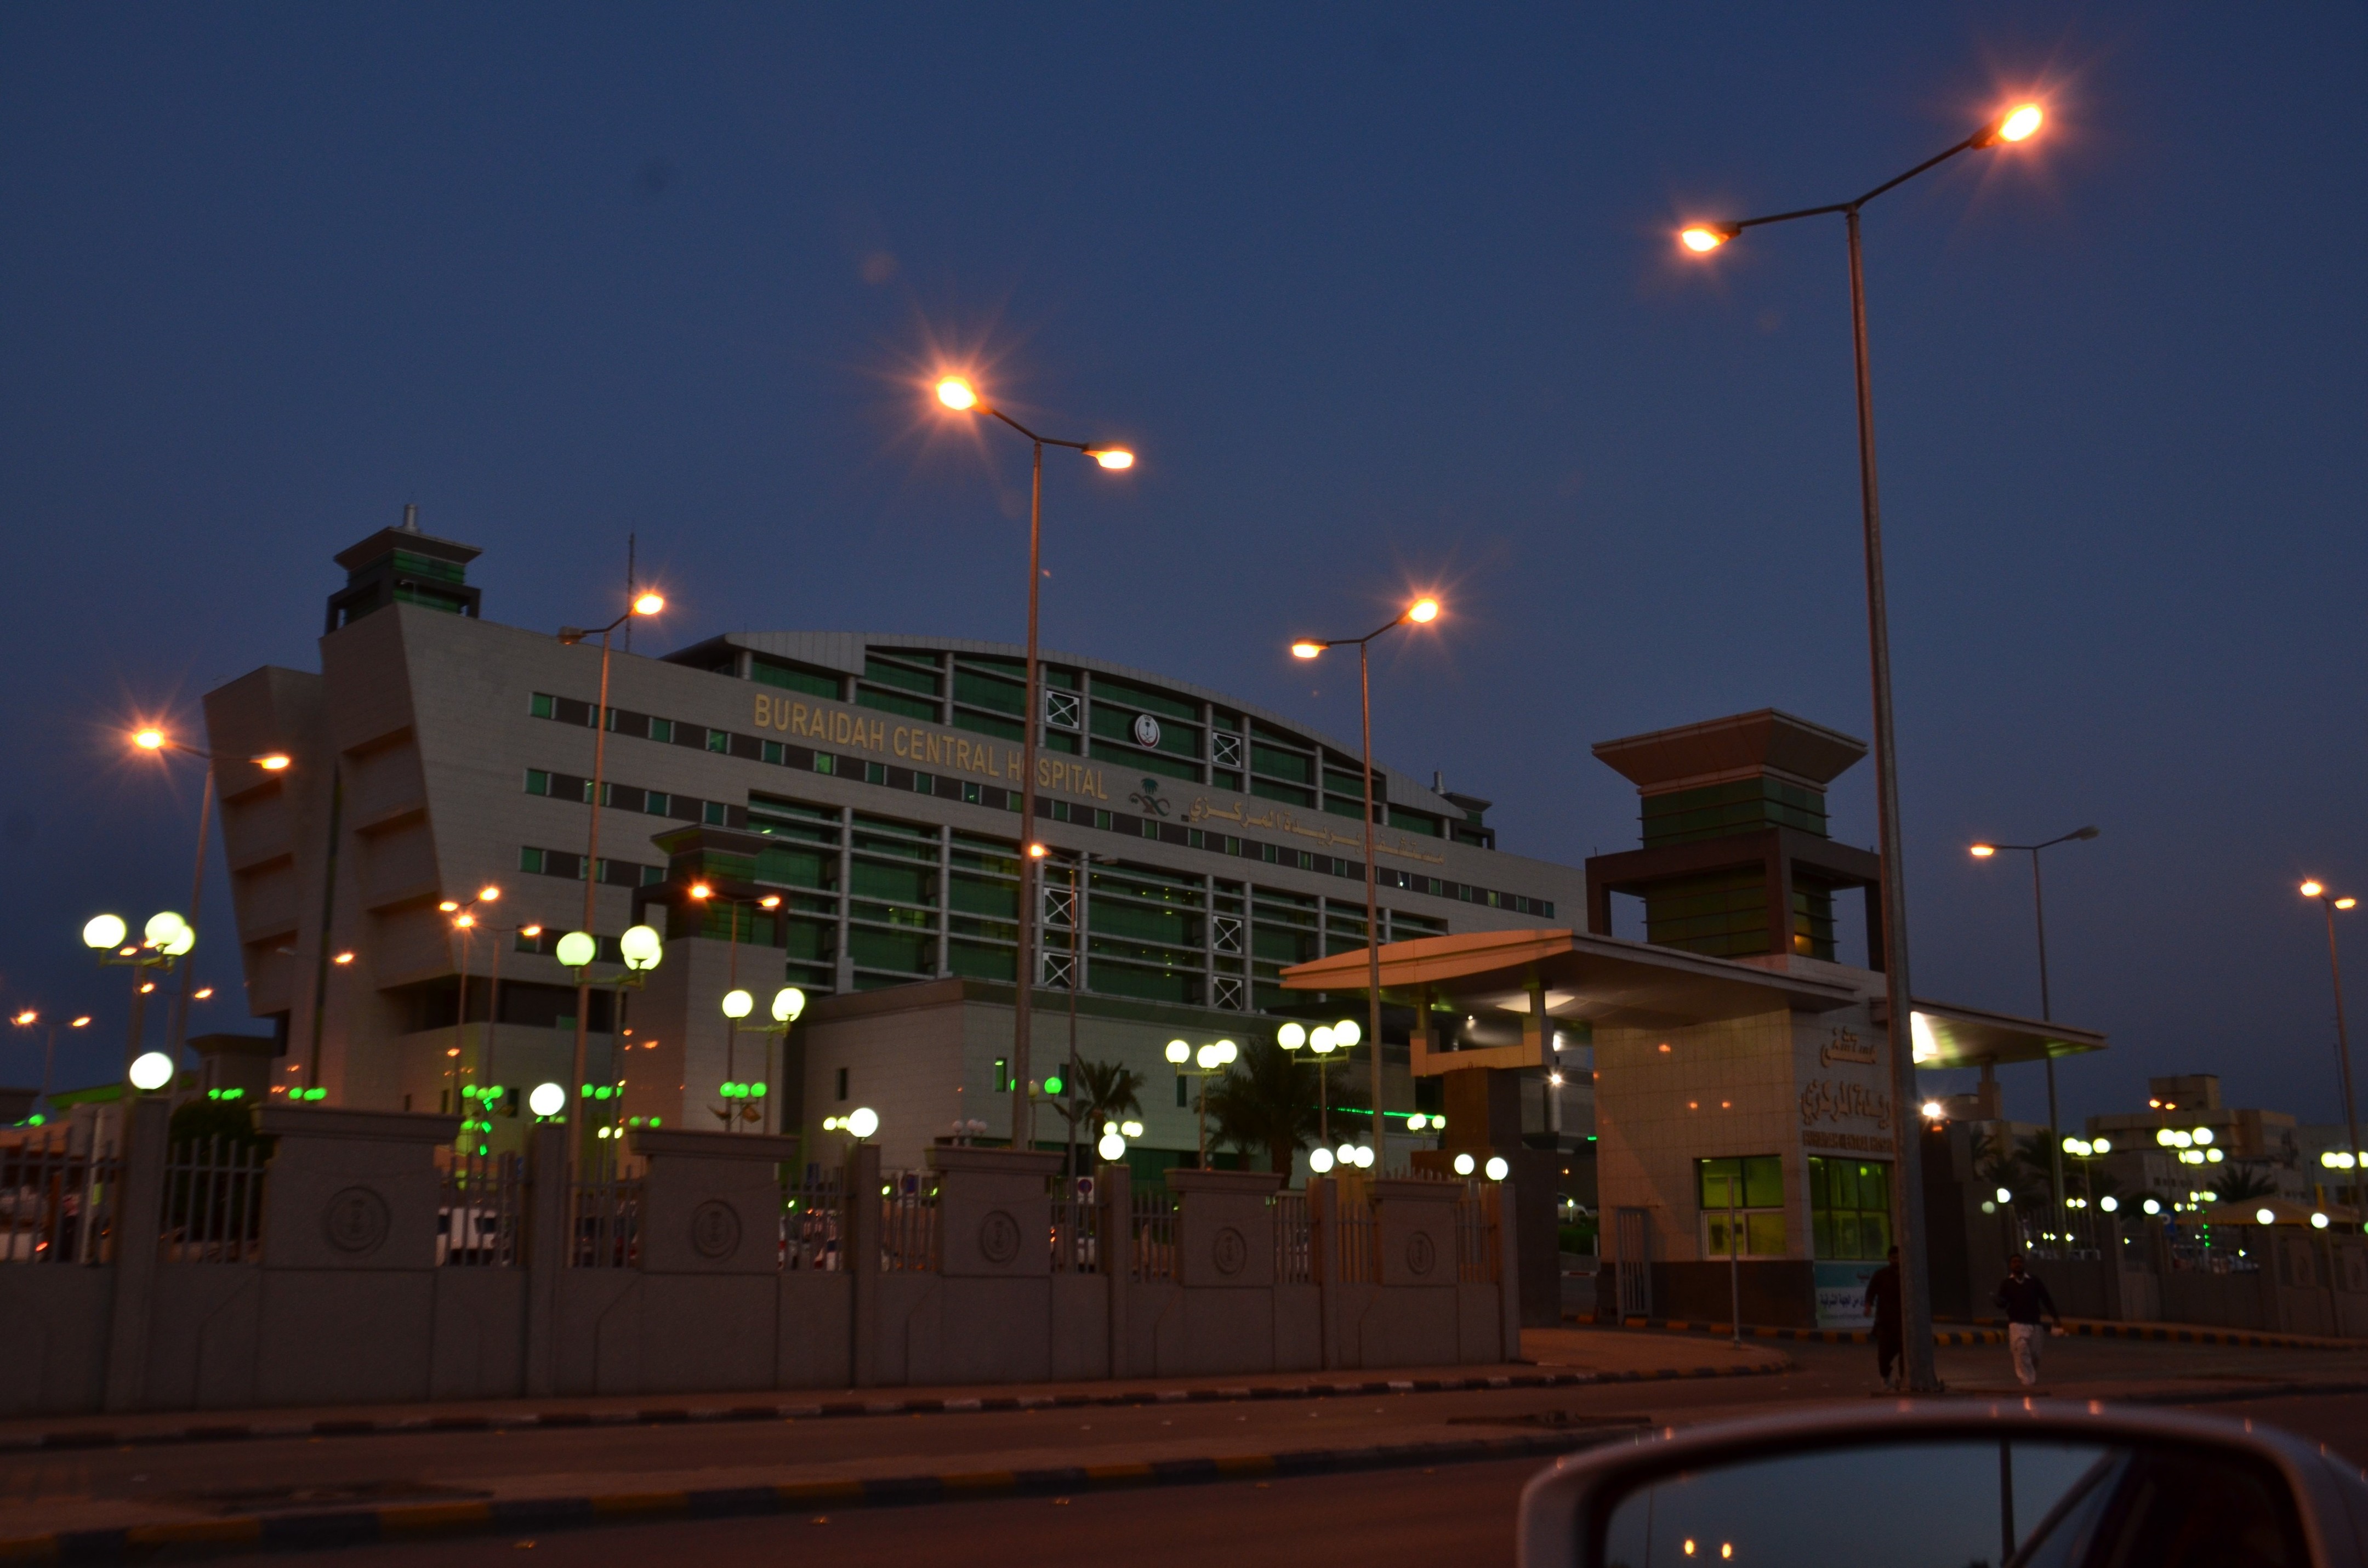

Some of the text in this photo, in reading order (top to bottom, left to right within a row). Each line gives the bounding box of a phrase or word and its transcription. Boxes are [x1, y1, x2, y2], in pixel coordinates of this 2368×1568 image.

[754, 693, 1109, 801] BURAIDAH CENTRAL HSPITAL
[1189, 797, 1281, 830] المركزي
[1283, 810, 1361, 854] بريدة
[1801, 1078, 1852, 1126] المركزي
